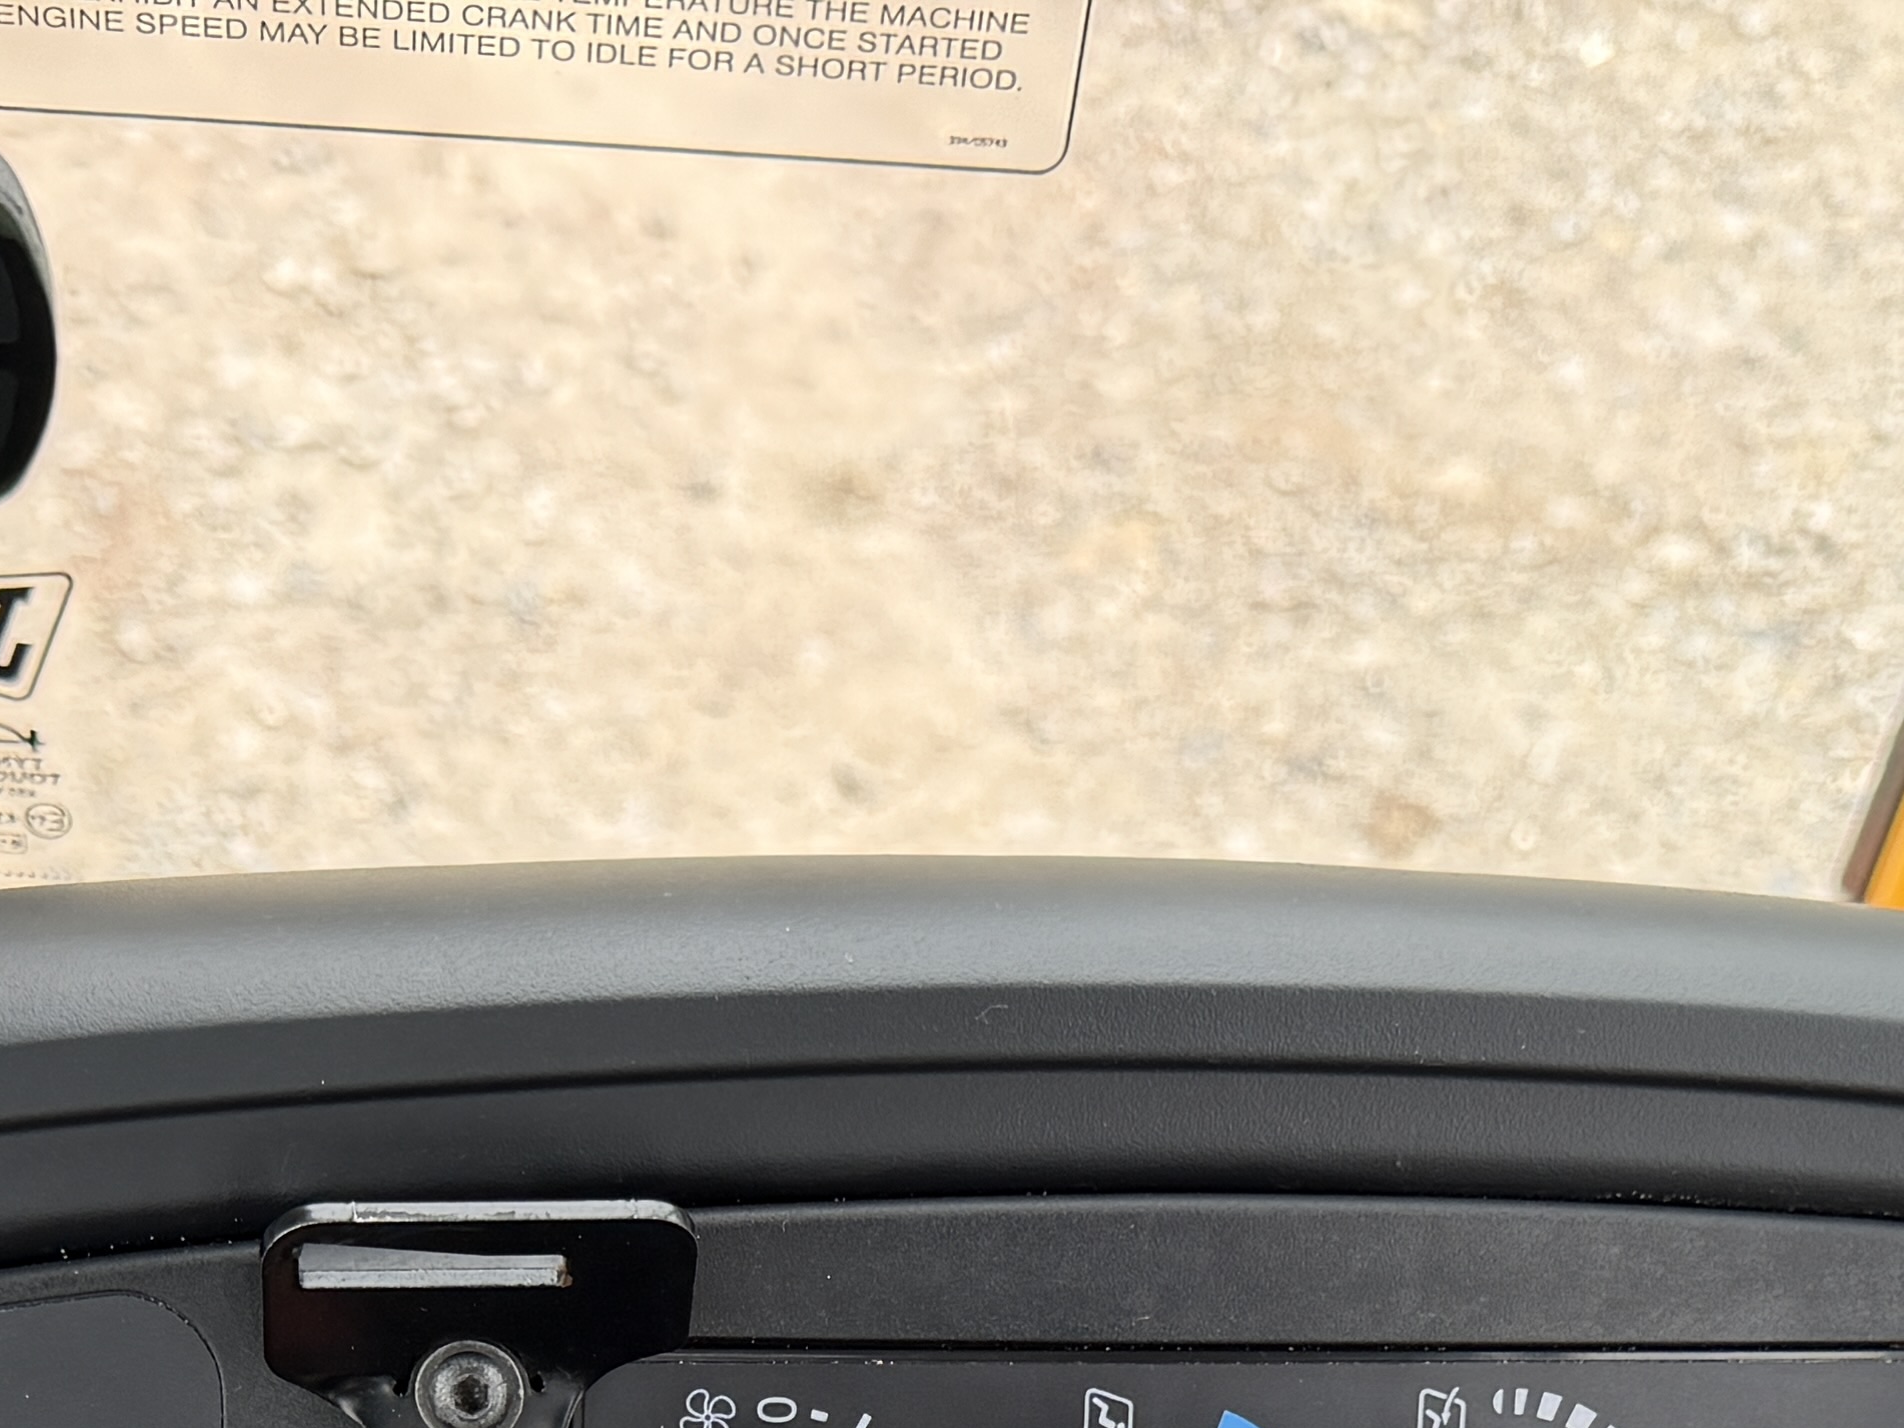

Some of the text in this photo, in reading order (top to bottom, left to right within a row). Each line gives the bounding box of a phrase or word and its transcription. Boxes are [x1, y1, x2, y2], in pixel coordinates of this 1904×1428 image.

[272, 0, 450, 24] EXTENDED
[460, 4, 576, 34] CRANK
[587, 13, 662, 39] TIME
[673, 19, 742, 45] AND
[754, 23, 847, 52] ONCE
[858, 30, 1003, 61] STARTED
[810, 0, 870, 23] THE
[880, 3, 1030, 35] MACHINE
[136, 12, 248, 40] SPEED
[259, 21, 327, 46] MAY
[339, 26, 381, 49] BE
[393, 29, 520, 58] LIMITED
[532, 38, 575, 62] TO
[587, 42, 658, 67] IDLE
[668, 48, 735, 71] FOR
[744, 52, 766, 74] A
[775, 54, 888, 84] SHORT
[898, 63, 1023, 93] PERIOD.
